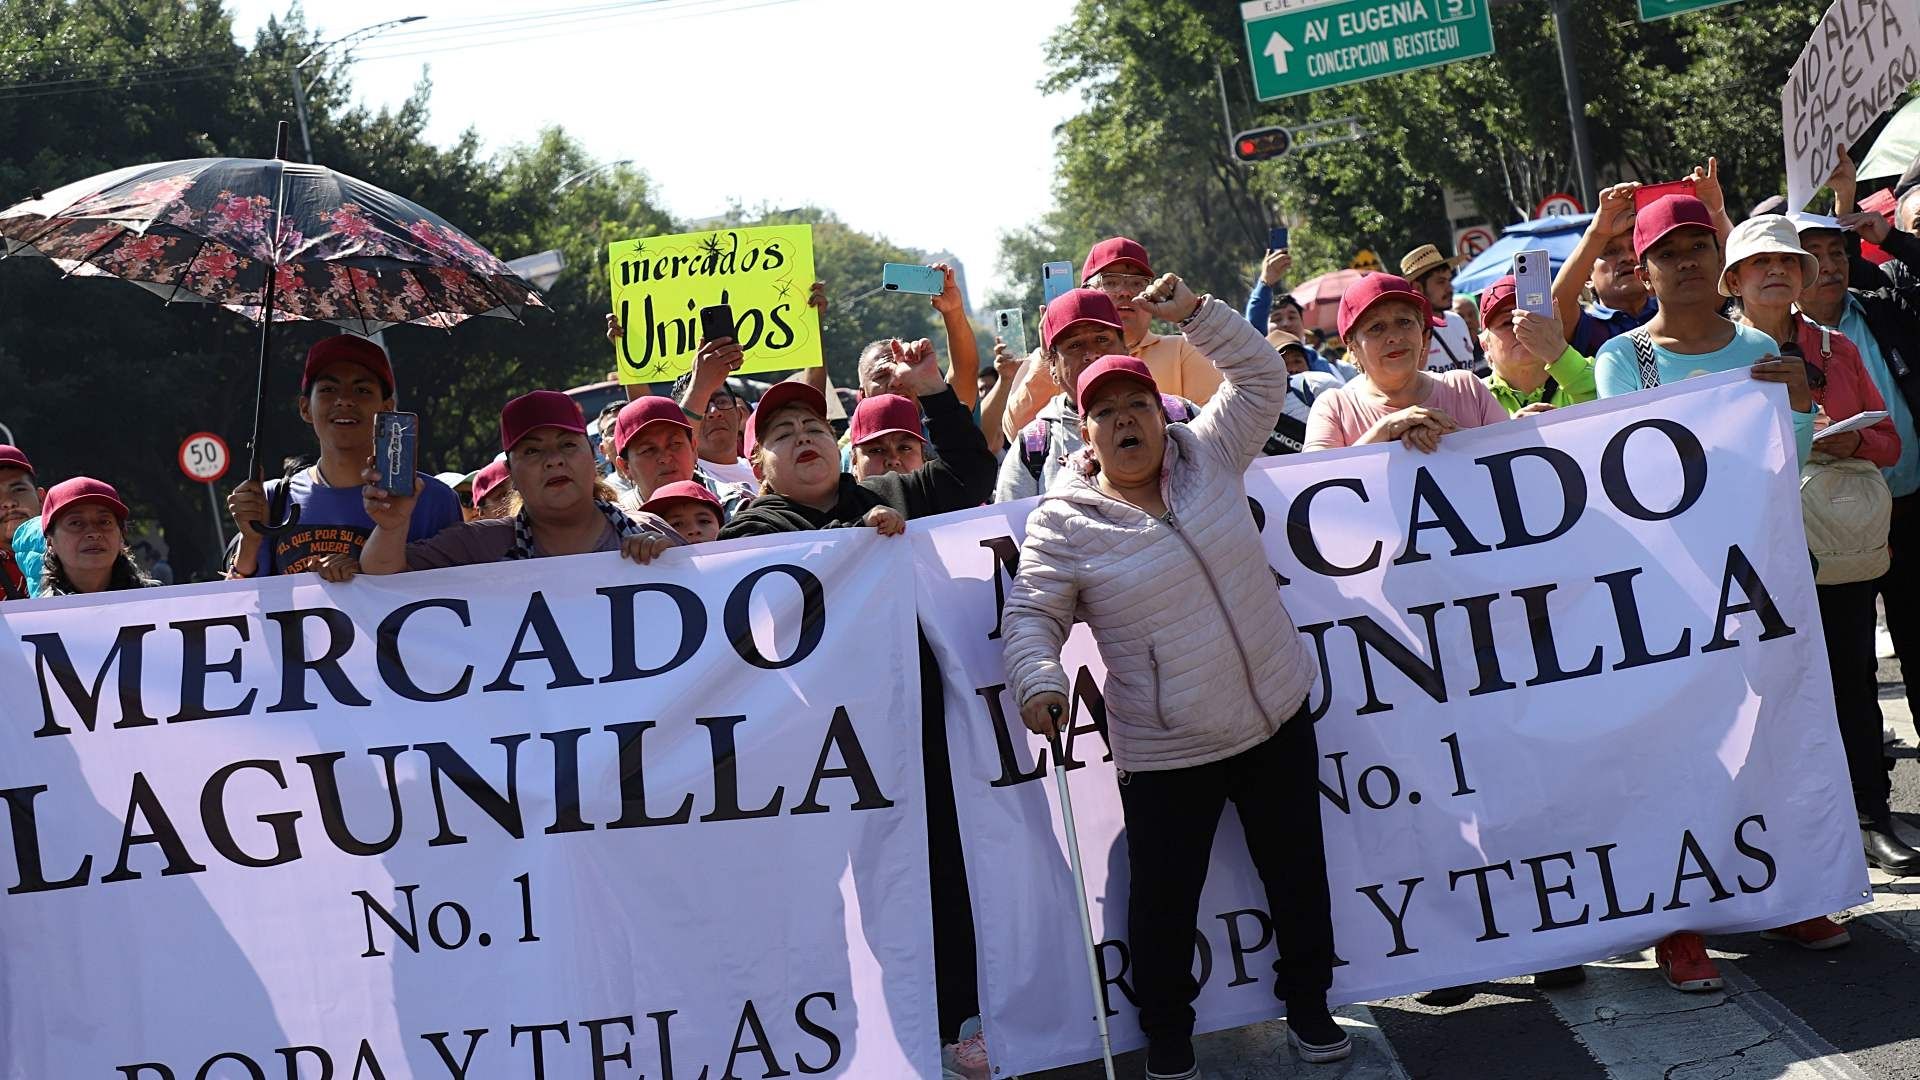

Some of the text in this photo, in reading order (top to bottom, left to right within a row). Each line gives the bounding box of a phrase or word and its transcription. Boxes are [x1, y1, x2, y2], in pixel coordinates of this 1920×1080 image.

[1303, 0, 1428, 44] AV EUGENIA
[1307, 25, 1460, 78] CONCEPCION BEISTEGUI
[1793, 44, 1821, 119] NO
[620, 232, 784, 286] mercados
[621, 288, 794, 370] Unios
[191, 441, 217, 465] 50
[291, 531, 312, 548] QUE
[315, 529, 337, 540] POR
[340, 529, 354, 541] SU
[310, 542, 350, 554] MUERE
[980, 419, 1707, 640] CADO
[22, 564, 825, 738] MERCADO
[975, 544, 1796, 787] LANILLA
[0, 706, 894, 895] LAGUNILLA
[1441, 732, 1476, 796] 1
[352, 873, 540, 957] No. 1
[1356, 877, 1424, 957] Y
[1449, 815, 1776, 942] TELAS
[421, 1029, 488, 1080] Y
[511, 992, 841, 1080] TELAS
